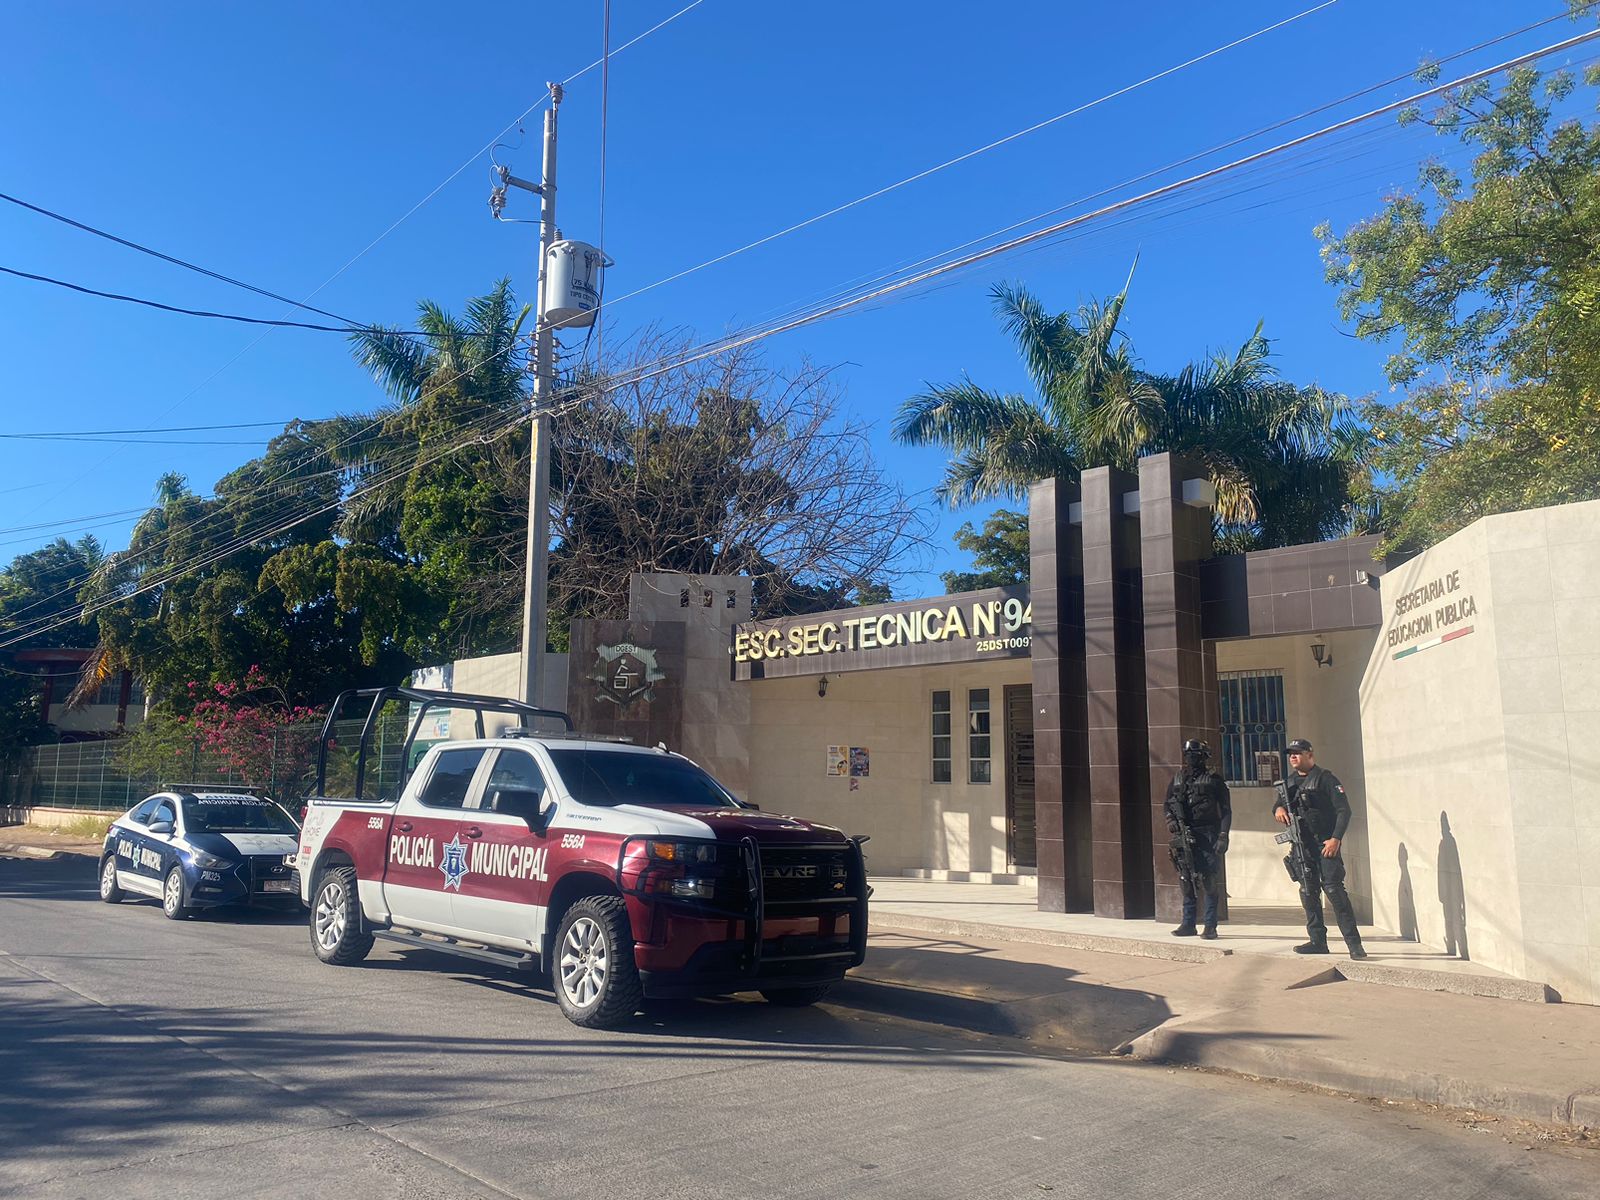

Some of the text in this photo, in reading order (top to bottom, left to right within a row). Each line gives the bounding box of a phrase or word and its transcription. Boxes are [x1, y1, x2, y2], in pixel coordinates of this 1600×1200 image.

[1395, 569, 1460, 617] SECRETARIA DE
[1388, 595, 1477, 648] EDUCACION PUBLICA
[389, 834, 549, 882] POLICÍA MUNICIPAL
[560, 833, 585, 849] 556A
